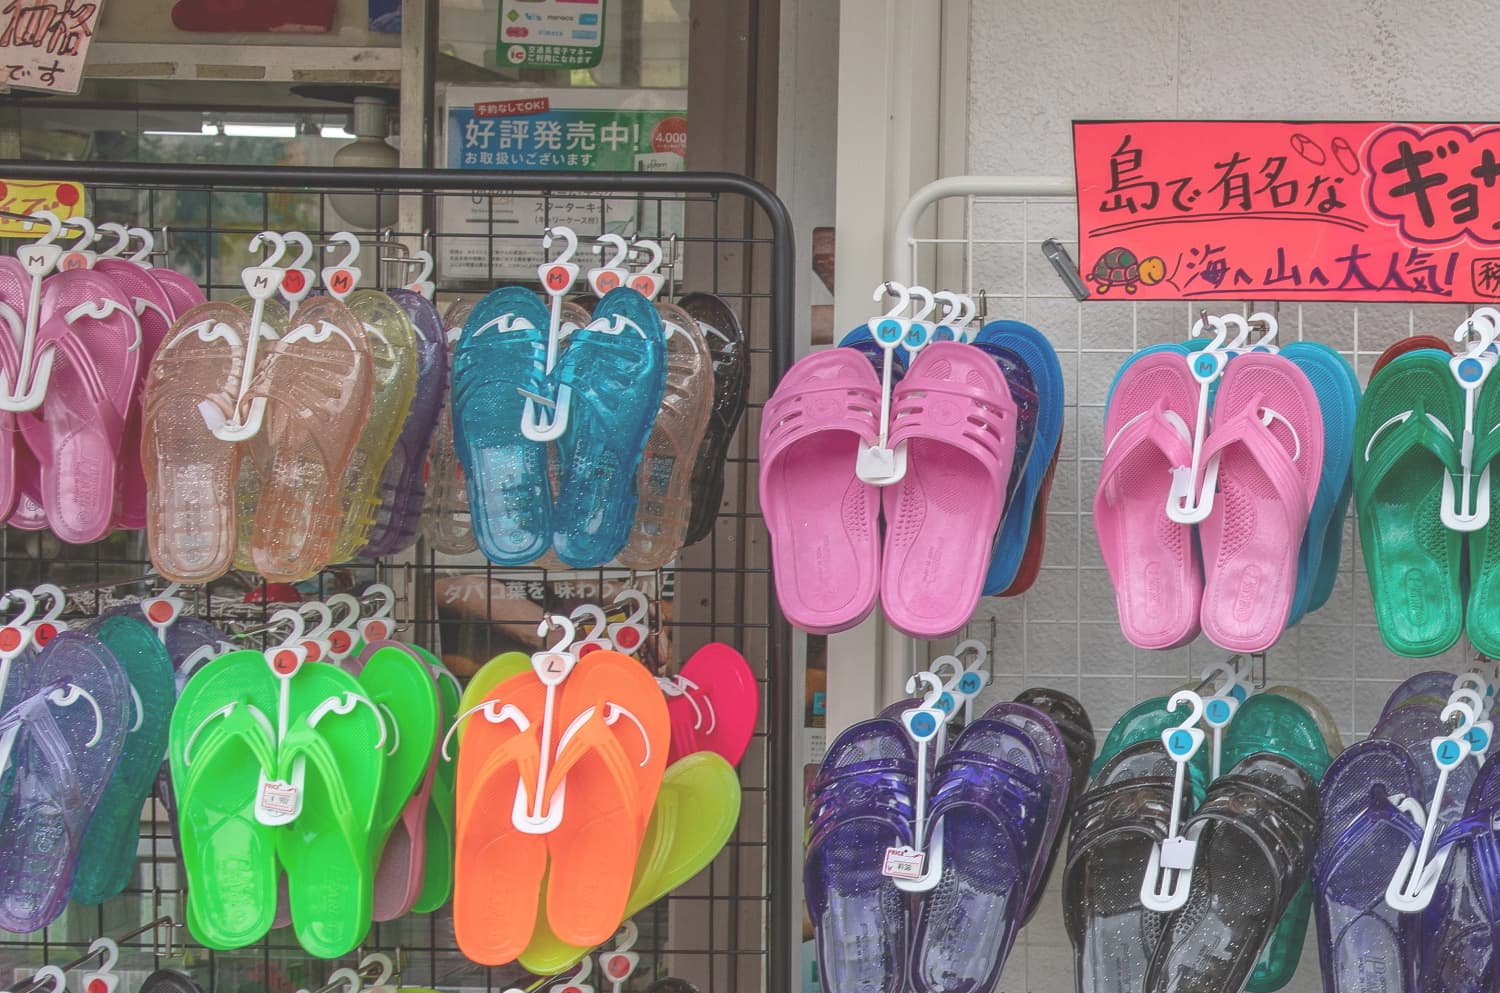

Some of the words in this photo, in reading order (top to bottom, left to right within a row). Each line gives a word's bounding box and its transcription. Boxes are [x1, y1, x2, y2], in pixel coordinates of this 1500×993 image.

[6, 60, 65, 87] です
[465, 117, 640, 152] 好評発売中!
[1099, 134, 1346, 214] 島で有名な
[28, 255, 45, 267] M
[253, 276, 268, 289] M
[333, 275, 348, 288] M
[549, 273, 563, 284] M
[881, 326, 897, 336] M
[907, 331, 921, 343] M
[40, 628, 49, 641] L
[333, 636, 345, 648] L
[277, 658, 288, 669] L
[547, 661, 562, 673] L
[962, 679, 975, 690] M
[1212, 704, 1222, 718] L
[1174, 735, 1185, 749] L
[1468, 731, 1481, 744] L
[1441, 744, 1454, 759] L
